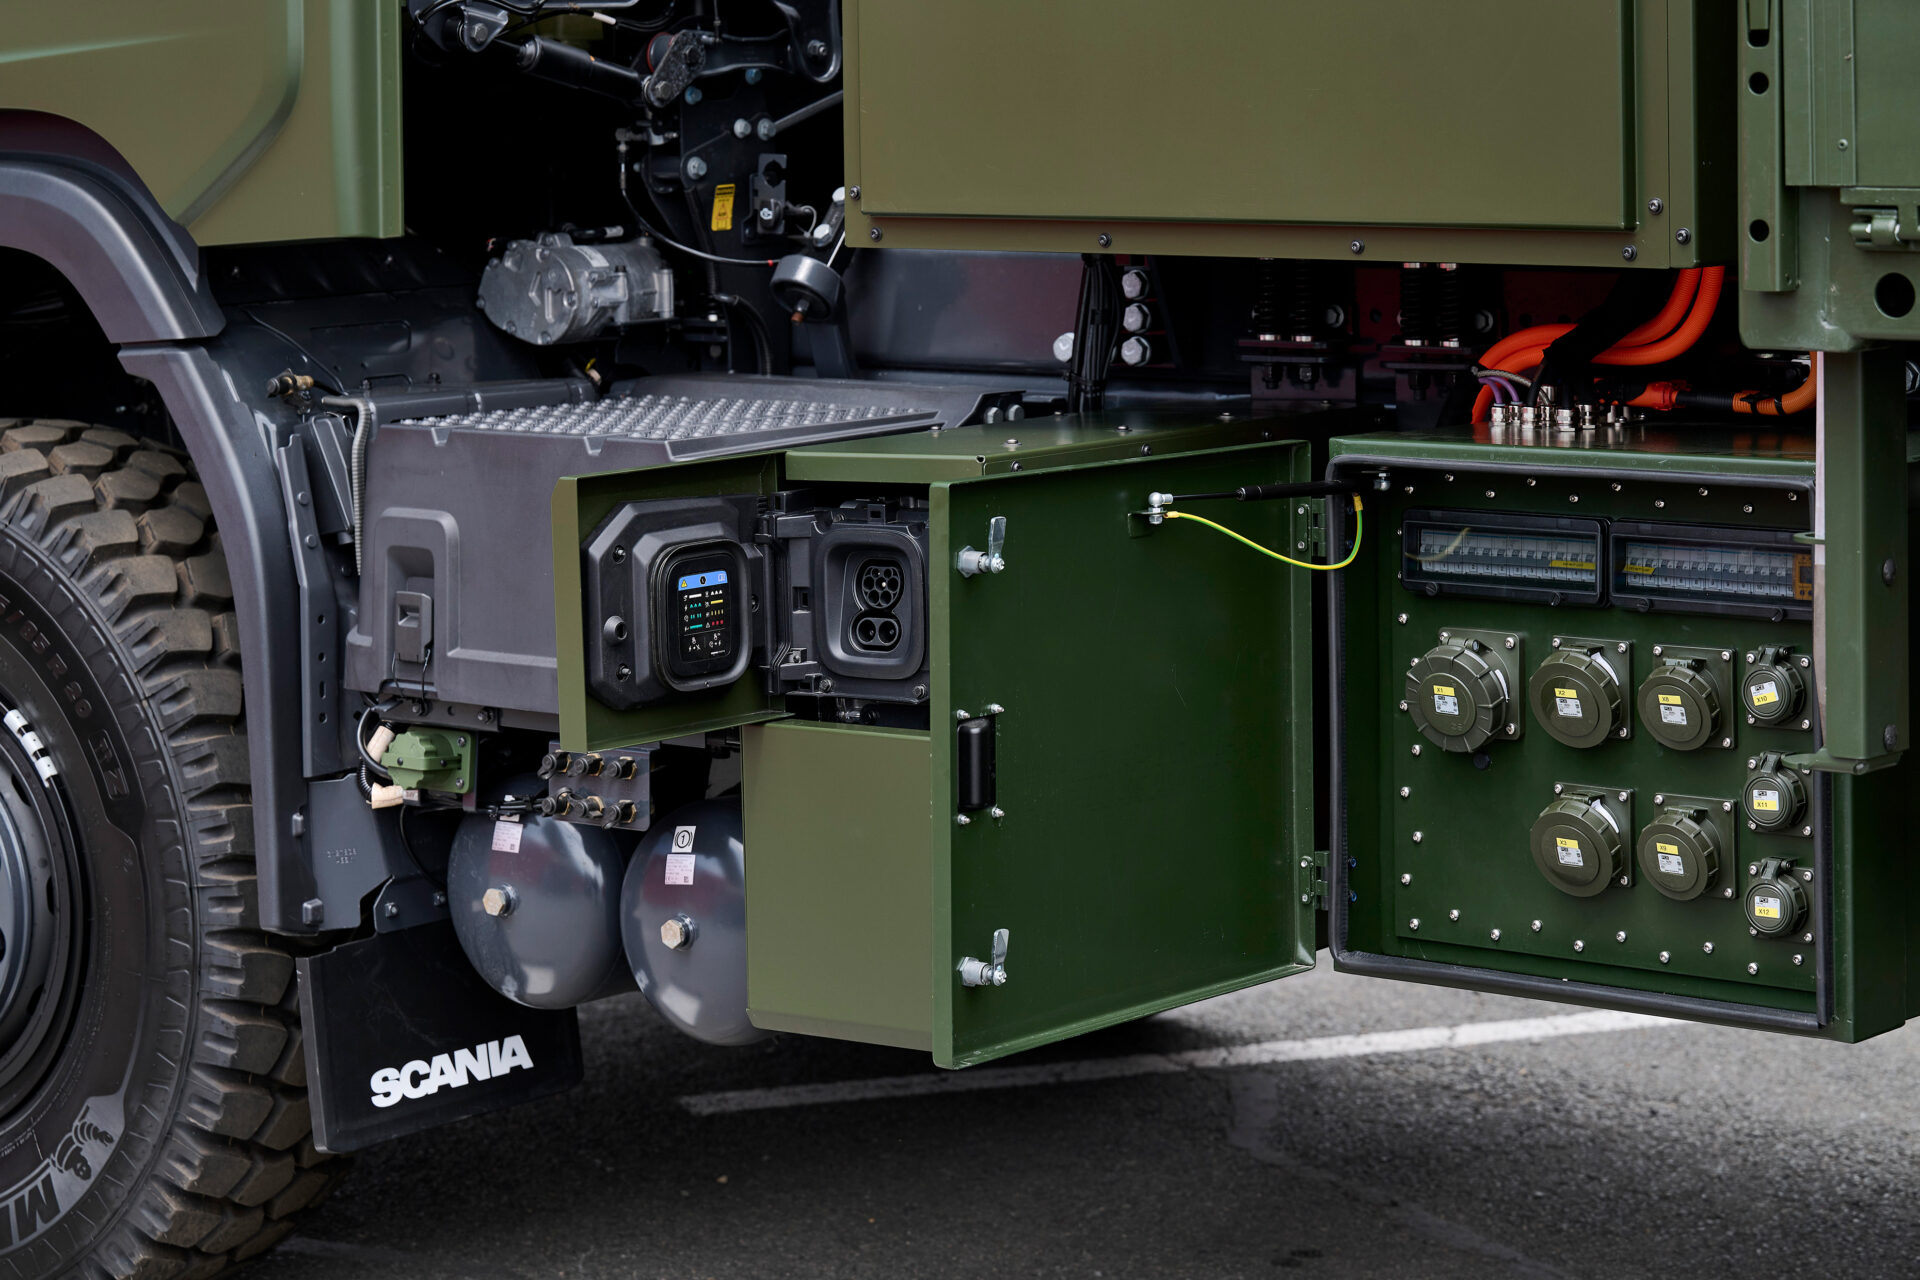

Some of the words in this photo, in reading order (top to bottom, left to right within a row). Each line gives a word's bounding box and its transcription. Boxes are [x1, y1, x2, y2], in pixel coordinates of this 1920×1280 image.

[46, 652, 69, 681] R
[64, 680, 93, 719] 20
[1756, 695, 1768, 703] X10
[369, 1034, 535, 1108] SCANIA
